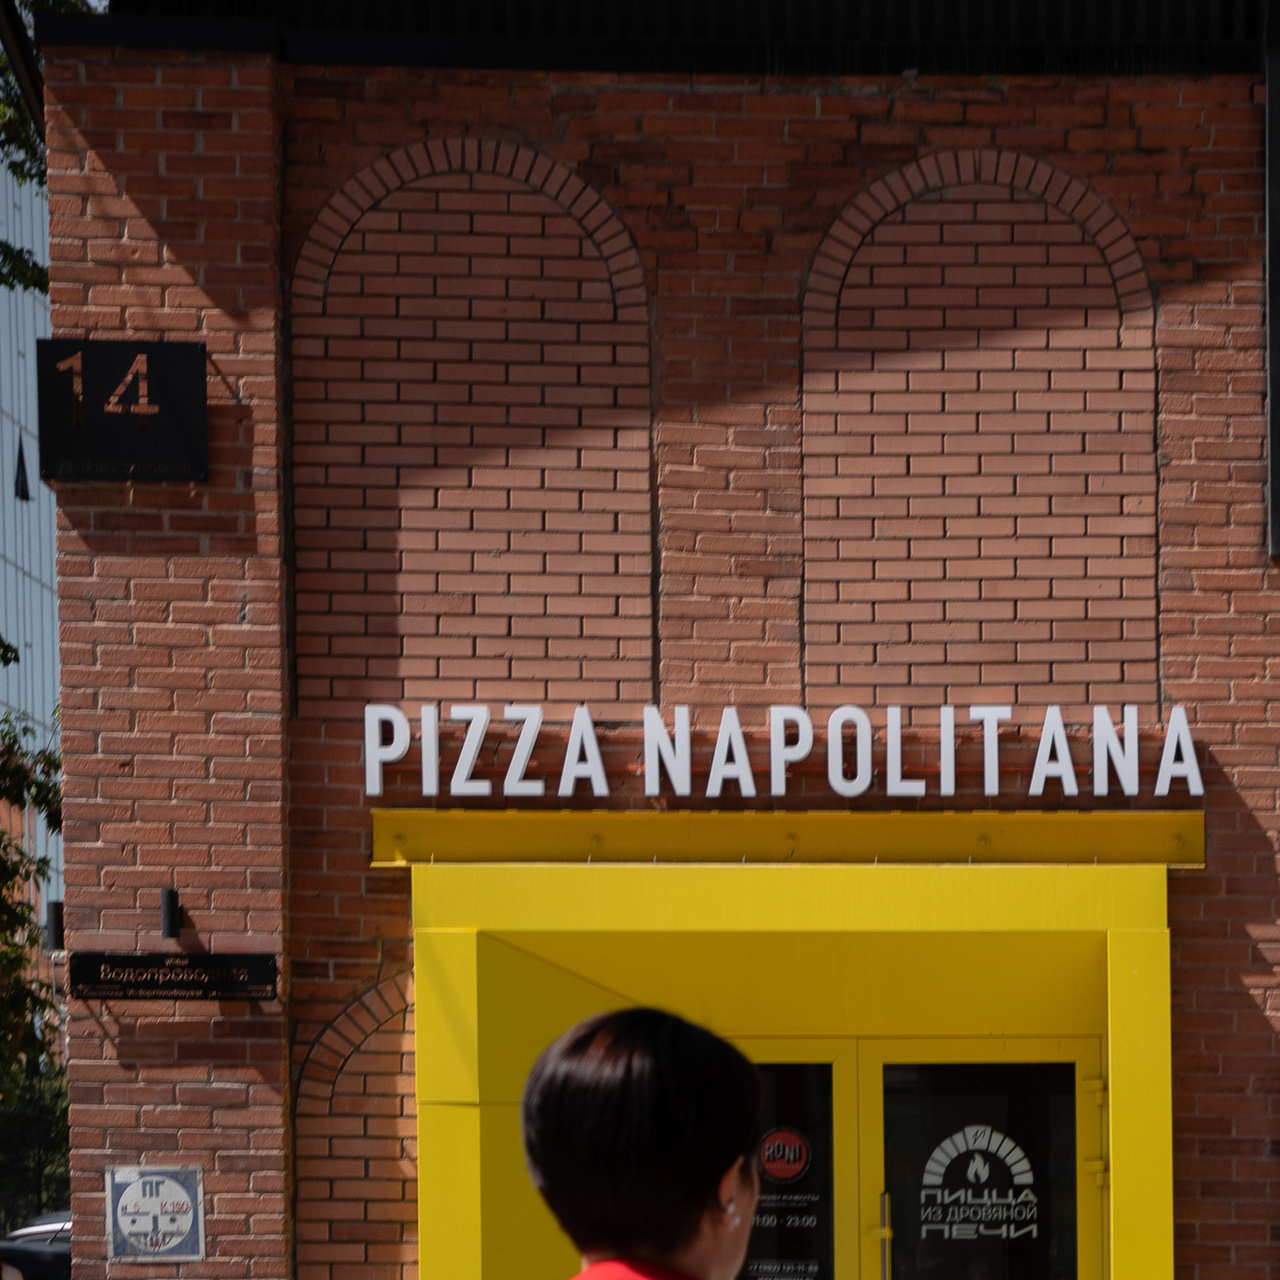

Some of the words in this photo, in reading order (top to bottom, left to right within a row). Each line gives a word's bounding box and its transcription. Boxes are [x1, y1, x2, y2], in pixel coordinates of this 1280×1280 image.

[56, 350, 160, 432] 14
[363, 703, 611, 798] PIZZA
[643, 703, 1206, 798] NAPOLITANA
[765, 1140, 802, 1163] RONI
[141, 1180, 165, 1199] ПГ
[920, 1188, 1038, 1207] ПИЦЦА
[786, 1214, 818, 1228] 23:00
[921, 1205, 943, 1222] ИЗ
[946, 1203, 1038, 1223] ДРОВЯНОЙ
[921, 1223, 1038, 1240] ПЕЧИ
